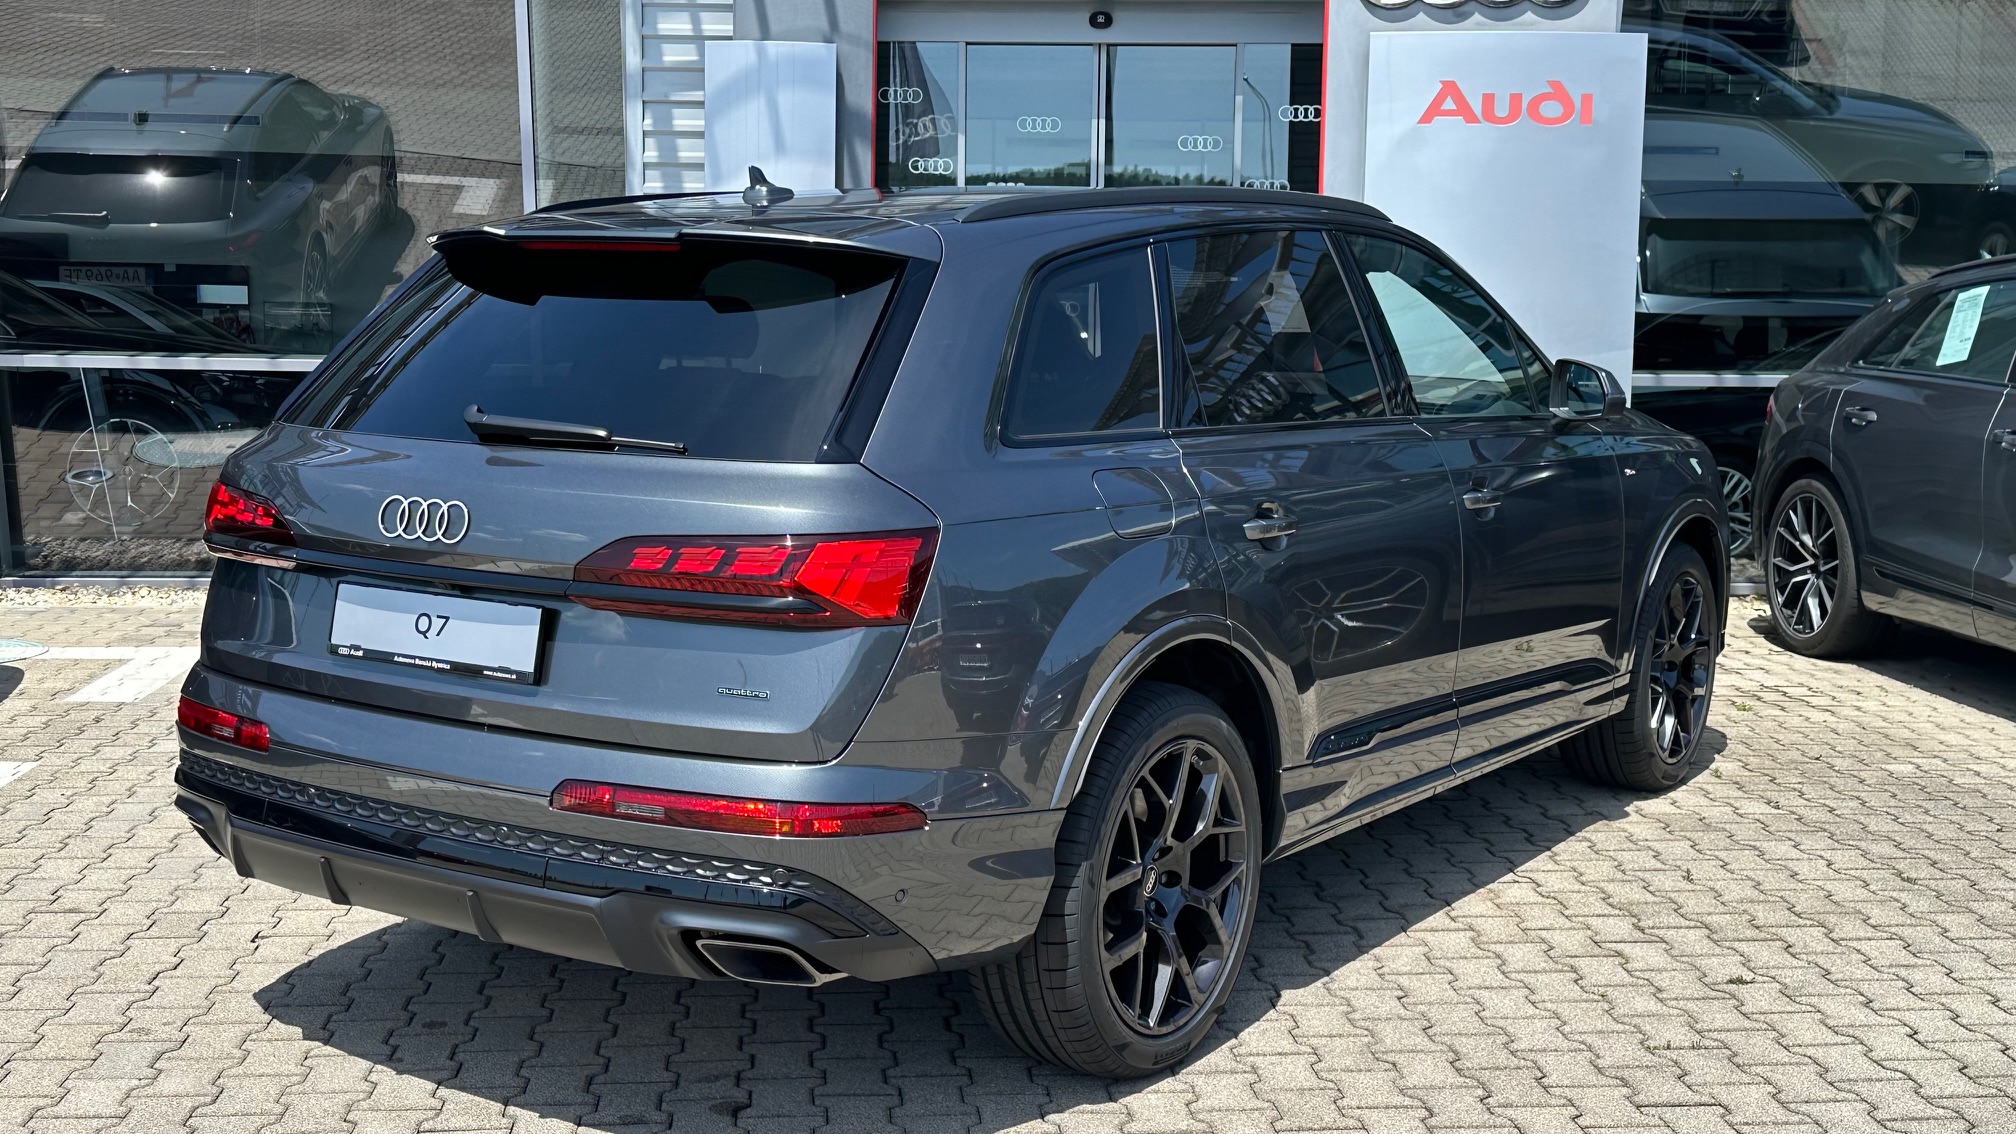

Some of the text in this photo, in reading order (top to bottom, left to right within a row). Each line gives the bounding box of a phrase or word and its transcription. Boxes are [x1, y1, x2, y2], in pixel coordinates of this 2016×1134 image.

[1416, 80, 1594, 127] Audi
[414, 612, 451, 640] Q7
[350, 648, 364, 657] Audi
[718, 687, 768, 699] quattro
